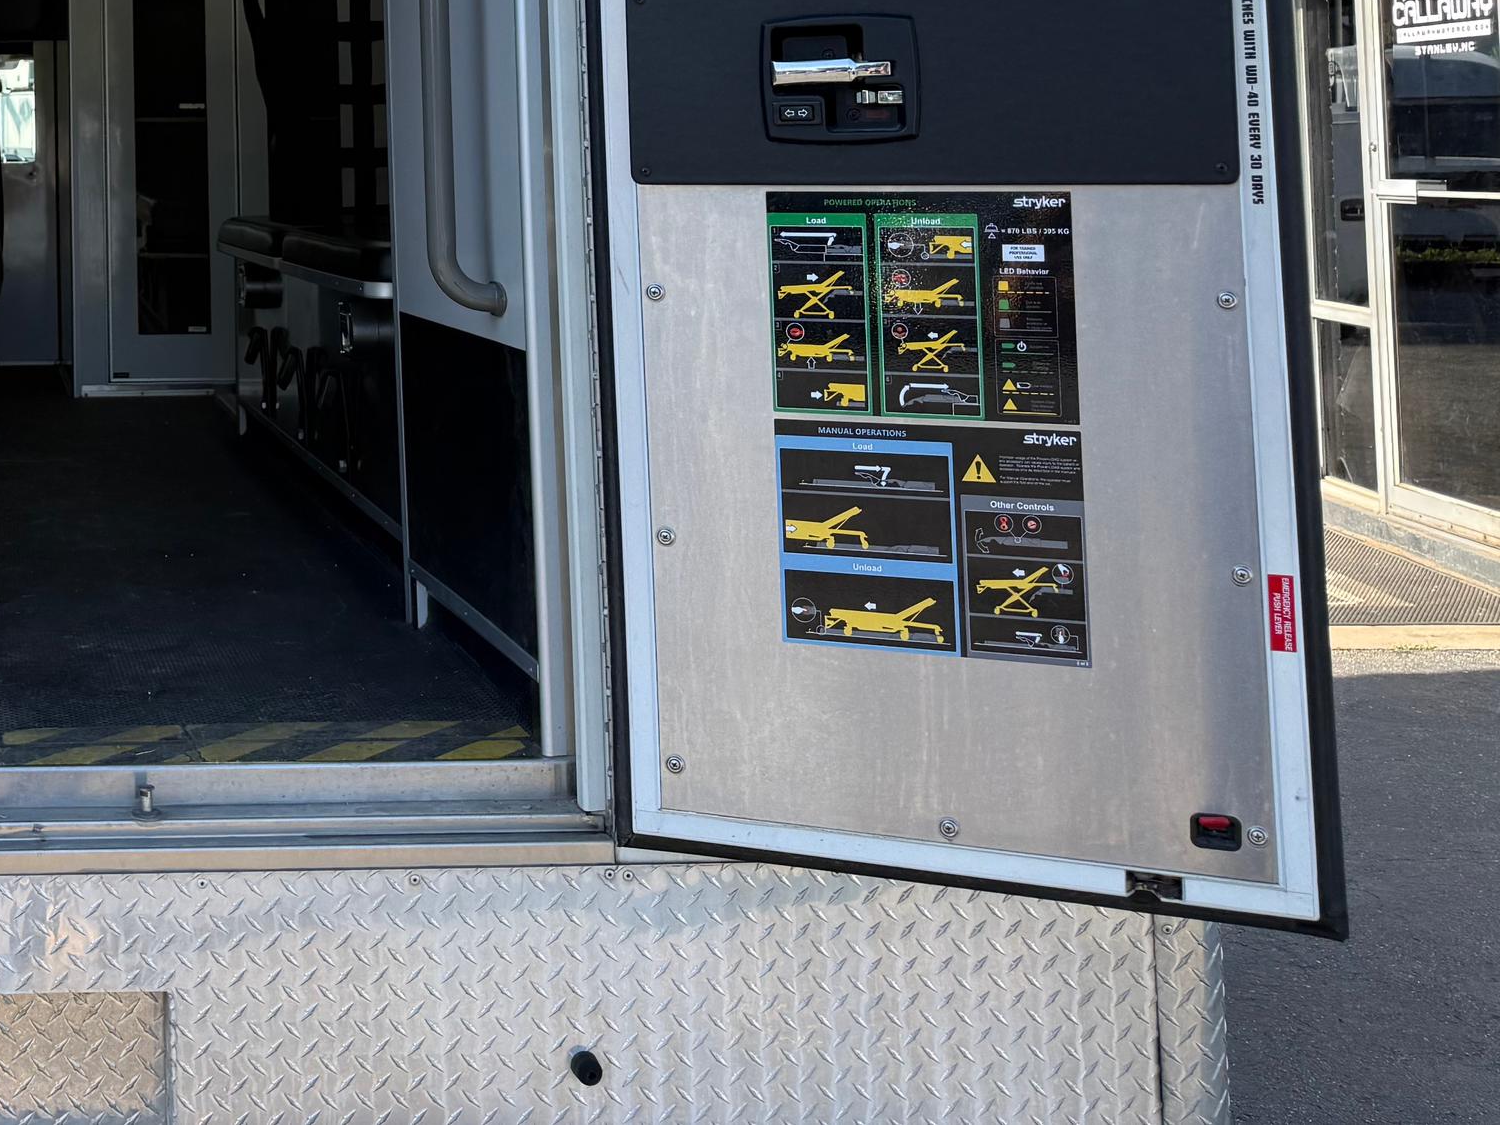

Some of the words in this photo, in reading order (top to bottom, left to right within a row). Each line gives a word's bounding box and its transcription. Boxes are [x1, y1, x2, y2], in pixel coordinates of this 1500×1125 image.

[1243, 30, 1257, 59] WITH
[1245, 65, 1259, 107] WD-40
[1248, 112, 1262, 149] EVERY
[1250, 154, 1263, 170] 30
[1251, 175, 1264, 205] DAYS
[823, 198, 863, 206] POWERED
[864, 198, 917, 207] OPERATIONS
[1012, 195, 1066, 209] stryker
[805, 216, 827, 225] Load
[910, 216, 941, 226] Unload
[999, 267, 1015, 275] LED
[817, 426, 854, 435] MANUAL
[855, 428, 907, 438] OPERATIONS
[1022, 432, 1077, 447] stryker
[852, 442, 873, 451] Load
[989, 500, 1015, 510] Other
[1016, 501, 1055, 512] Controls
[852, 562, 882, 573] Unload
[1272, 592, 1281, 611] PUSH
[1282, 577, 1291, 619] EMERGENCY
[1274, 613, 1282, 635] LEVER
[1284, 620, 1293, 651] RELEASE
